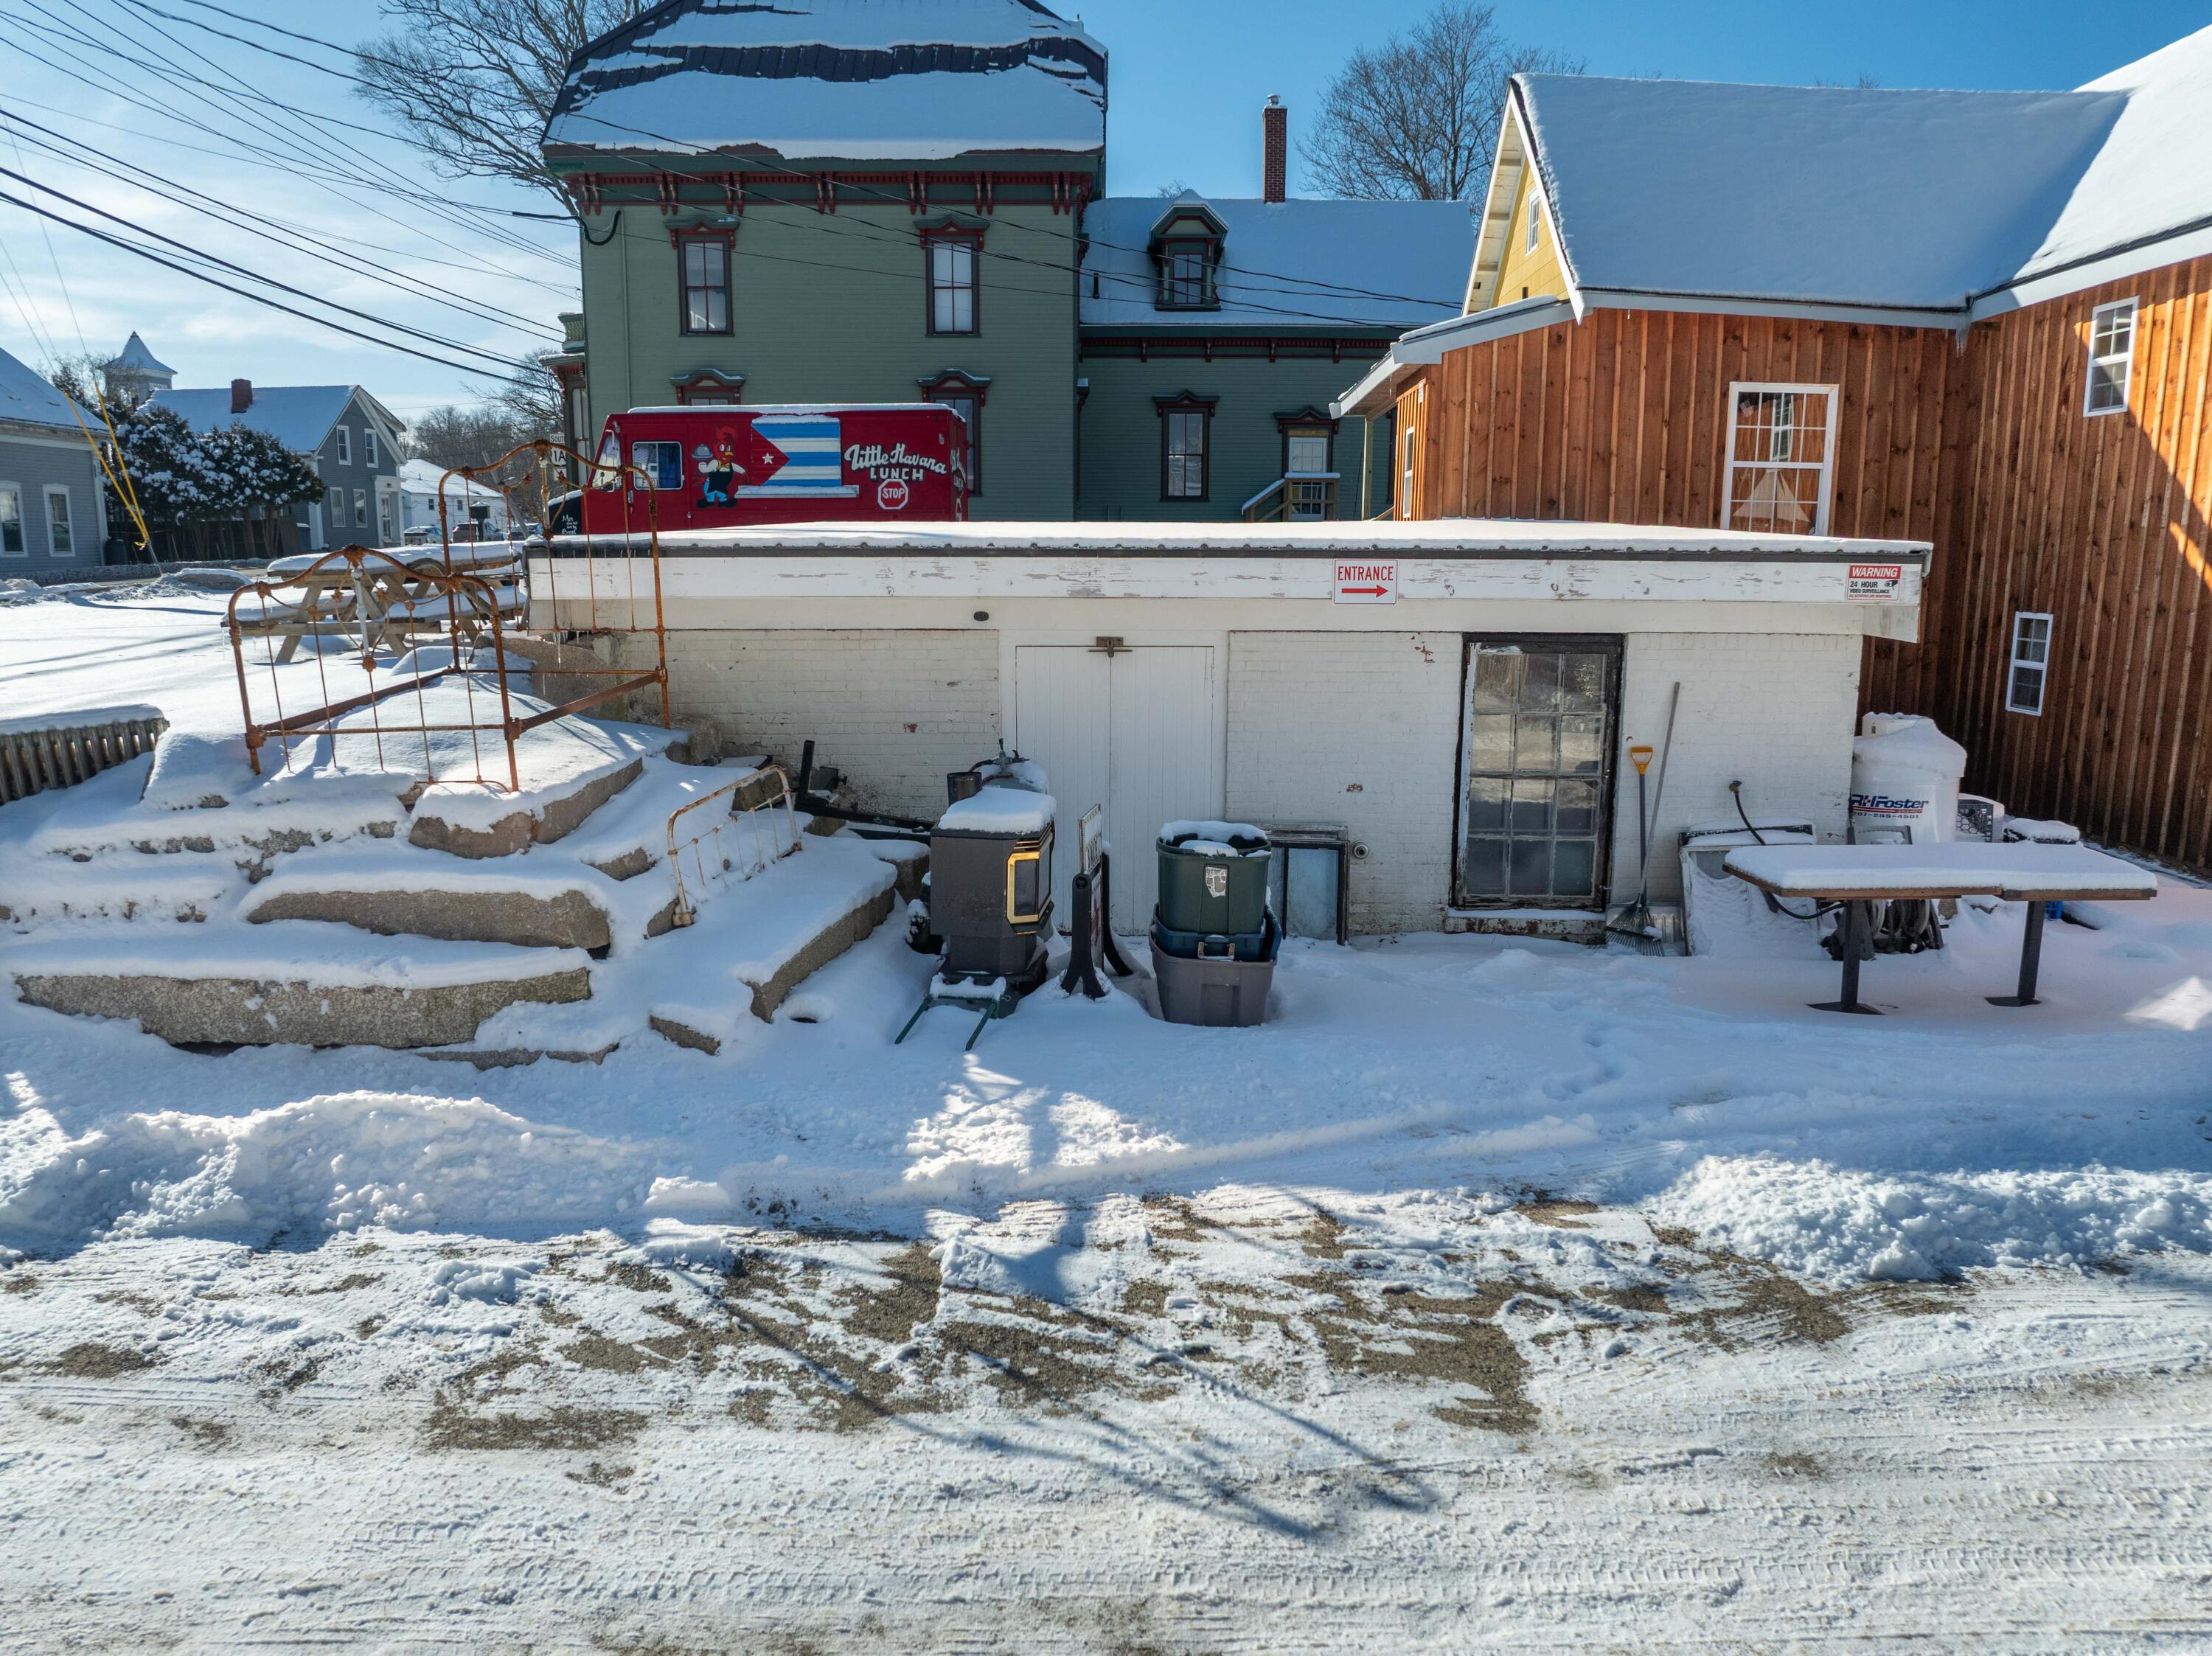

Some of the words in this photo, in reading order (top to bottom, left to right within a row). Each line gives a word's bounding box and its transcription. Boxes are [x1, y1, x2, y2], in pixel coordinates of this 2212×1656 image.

[844, 443, 890, 471] Little
[889, 442, 947, 475] Havana
[870, 467, 924, 481] LUNCH
[882, 487, 905, 500] STOP
[1338, 566, 1394, 581] ENTRANCE
[1852, 567, 1898, 577] WARNING
